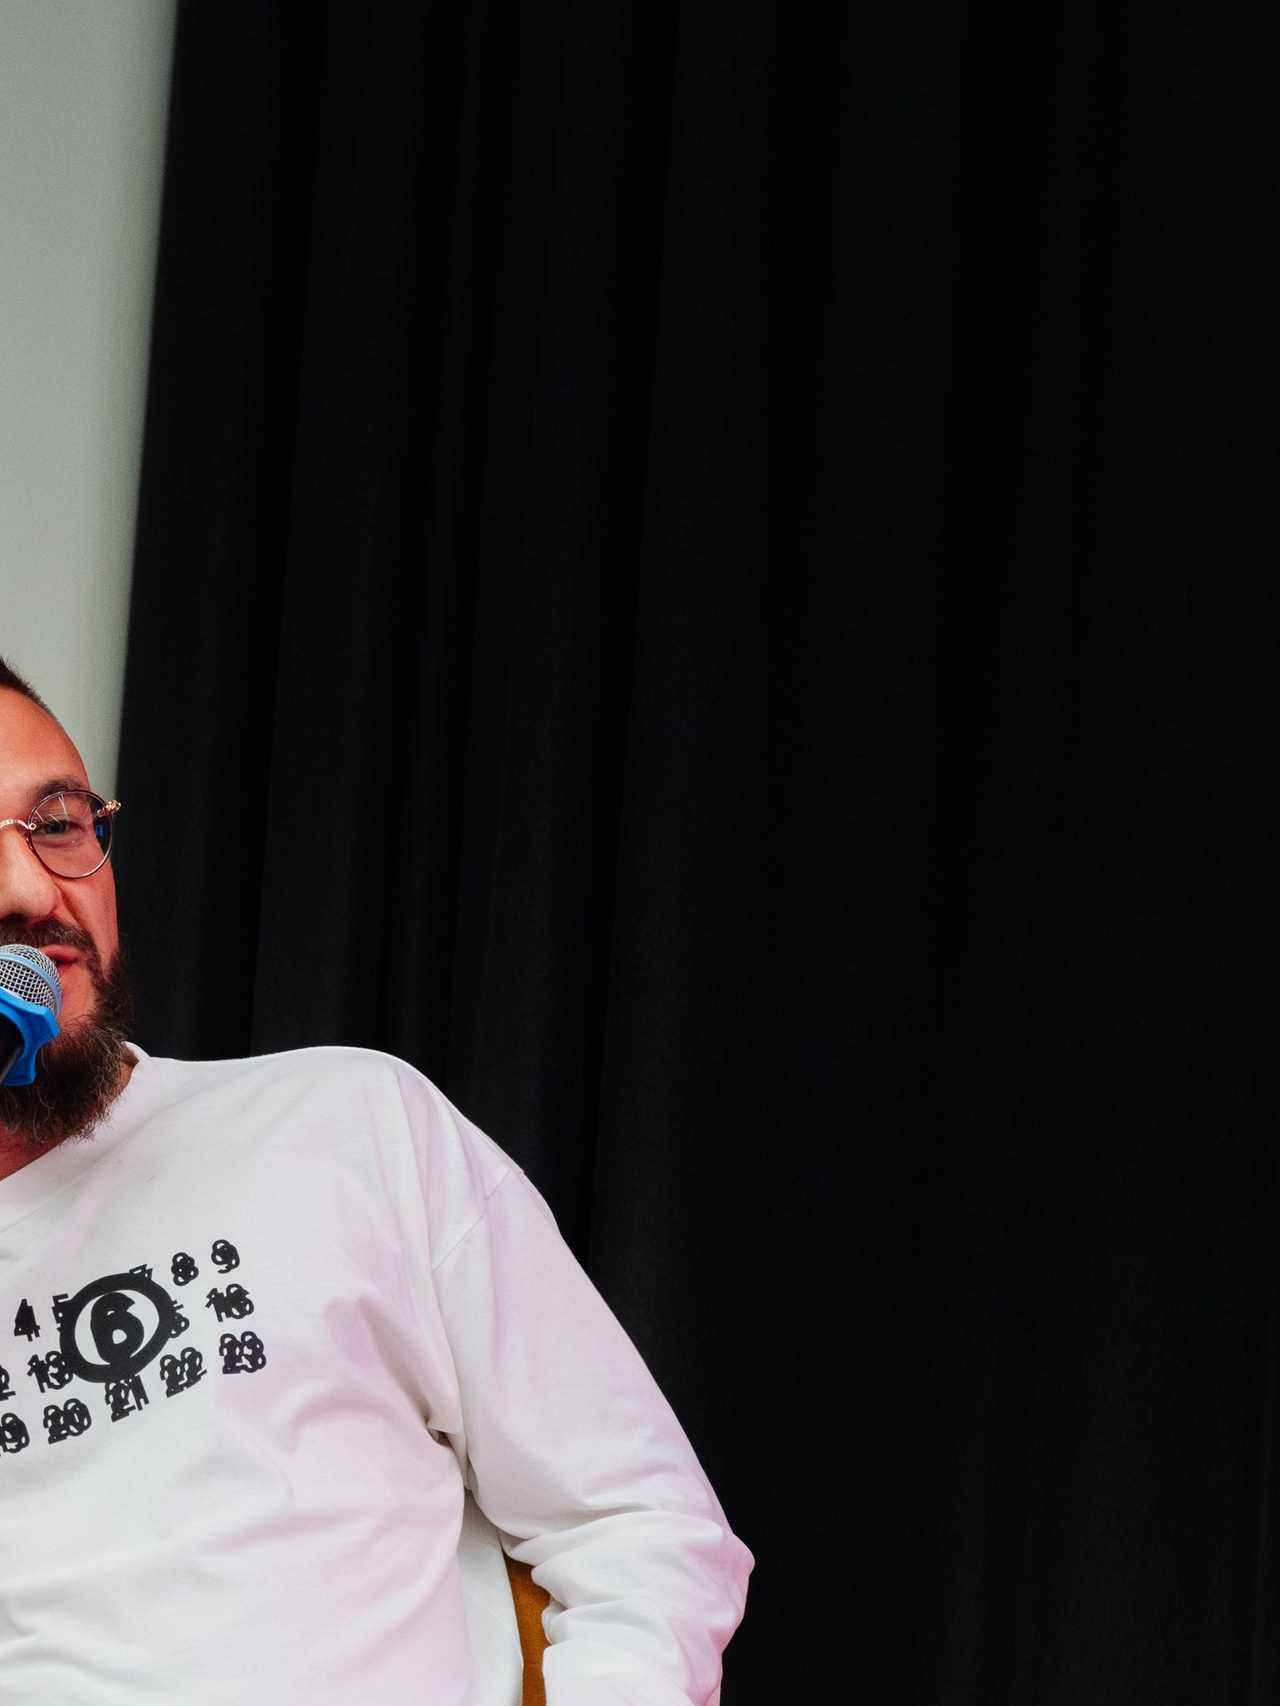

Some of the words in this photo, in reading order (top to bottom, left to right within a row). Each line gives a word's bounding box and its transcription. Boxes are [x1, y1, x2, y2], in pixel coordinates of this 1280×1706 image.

[14, 1299, 40, 1342] 4
[90, 1291, 145, 1367] 6
[171, 1252, 199, 1286] 8
[211, 1239, 241, 1273] 9
[27, 1350, 74, 1393] 13
[43, 1398, 92, 1444] 20
[105, 1375, 149, 1422] 21
[160, 1347, 207, 1397] 22
[219, 1331, 267, 1374] 23
